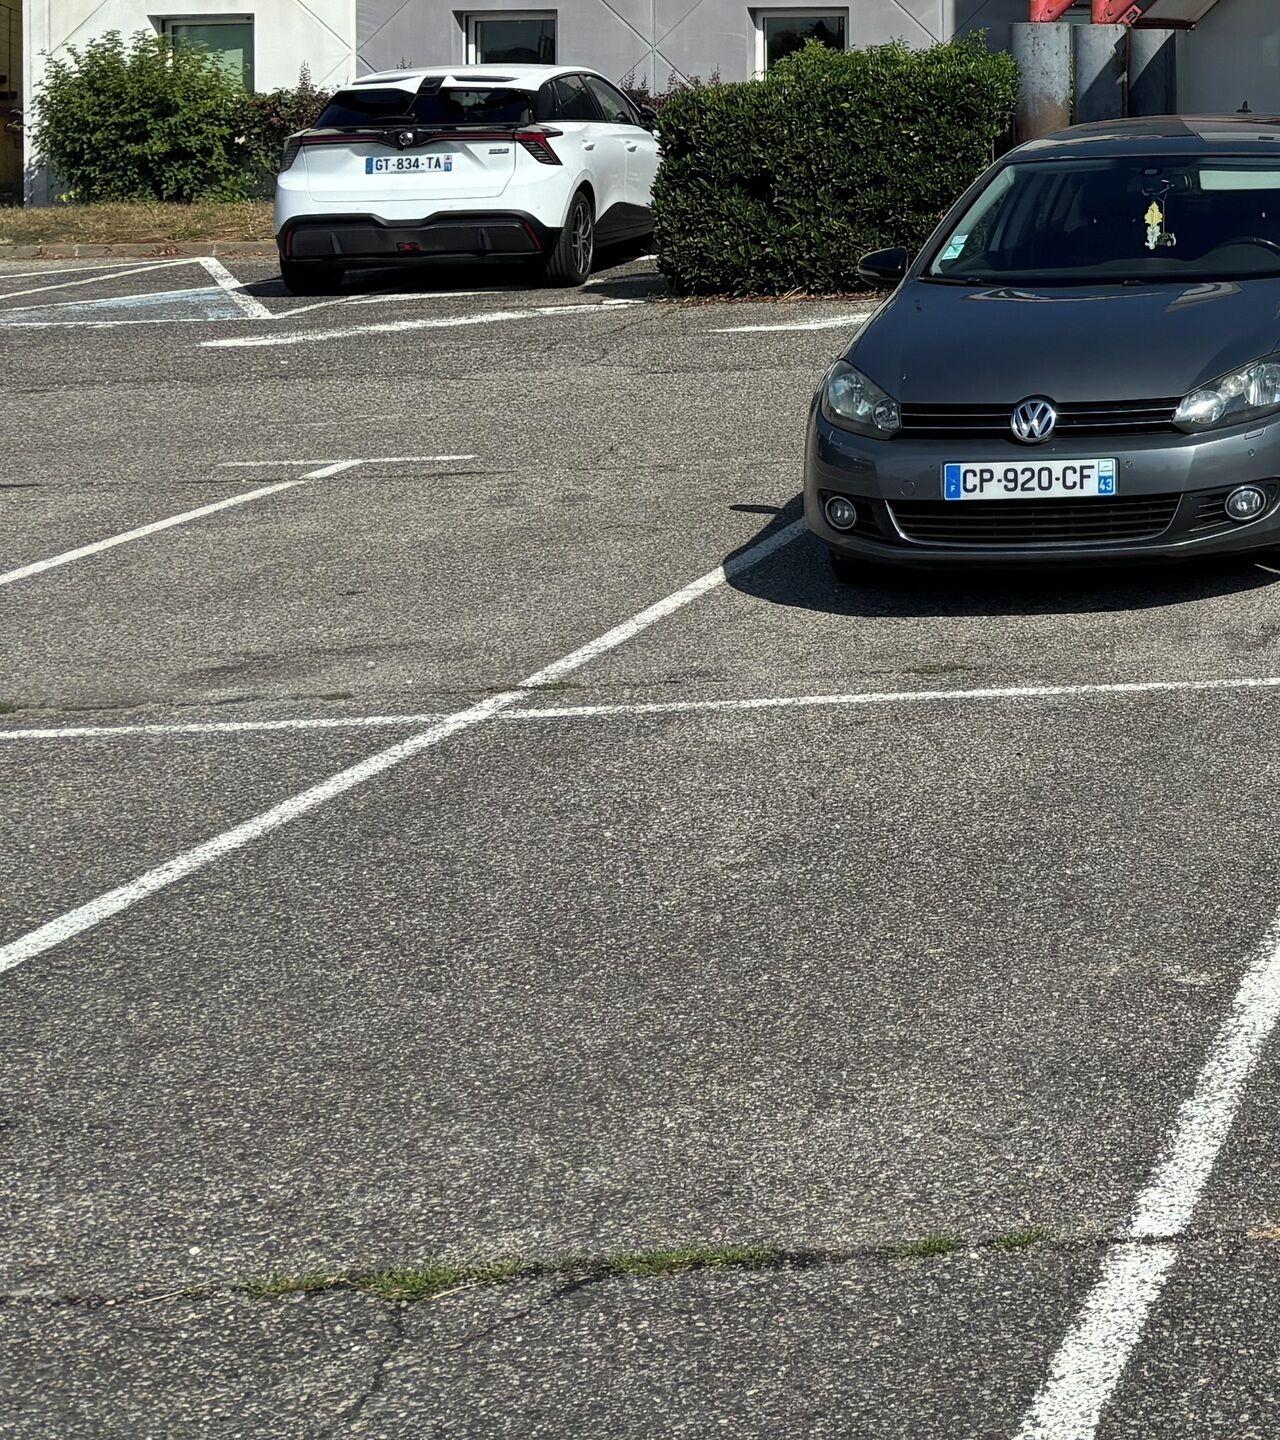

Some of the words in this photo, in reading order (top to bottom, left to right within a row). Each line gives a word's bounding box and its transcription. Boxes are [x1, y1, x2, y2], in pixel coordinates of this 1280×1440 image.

[375, 156, 442, 171] GT-834-TA
[962, 464, 1095, 494] CP-920-CF
[1099, 477, 1113, 491] 43
